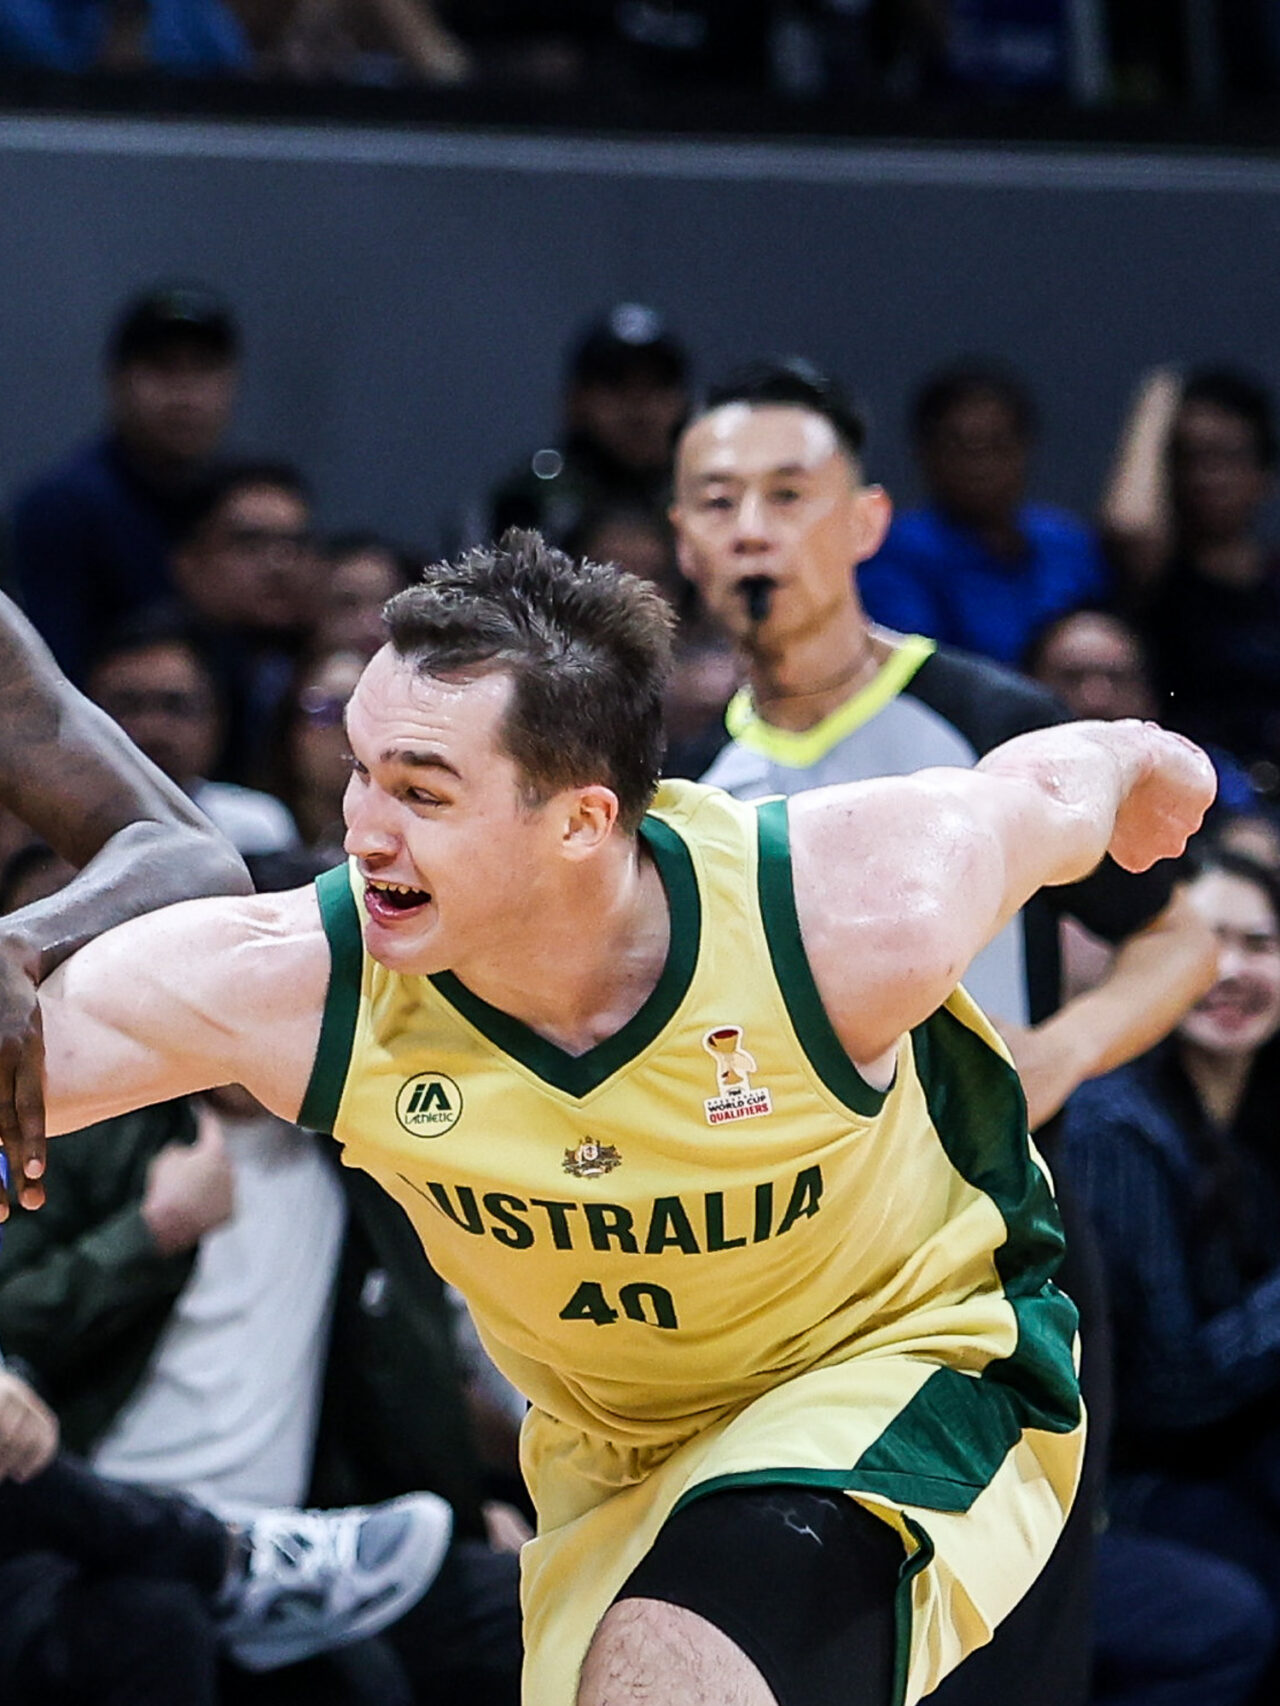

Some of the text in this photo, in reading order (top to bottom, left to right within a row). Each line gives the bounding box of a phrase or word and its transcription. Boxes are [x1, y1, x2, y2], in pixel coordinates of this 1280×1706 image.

[708, 1100, 745, 1112] WORLD
[746, 1095, 767, 1106] CUP
[709, 1103, 769, 1123] QUALIFIERS
[400, 1164, 824, 1255] USTRALIA
[559, 1280, 678, 1330] 40
